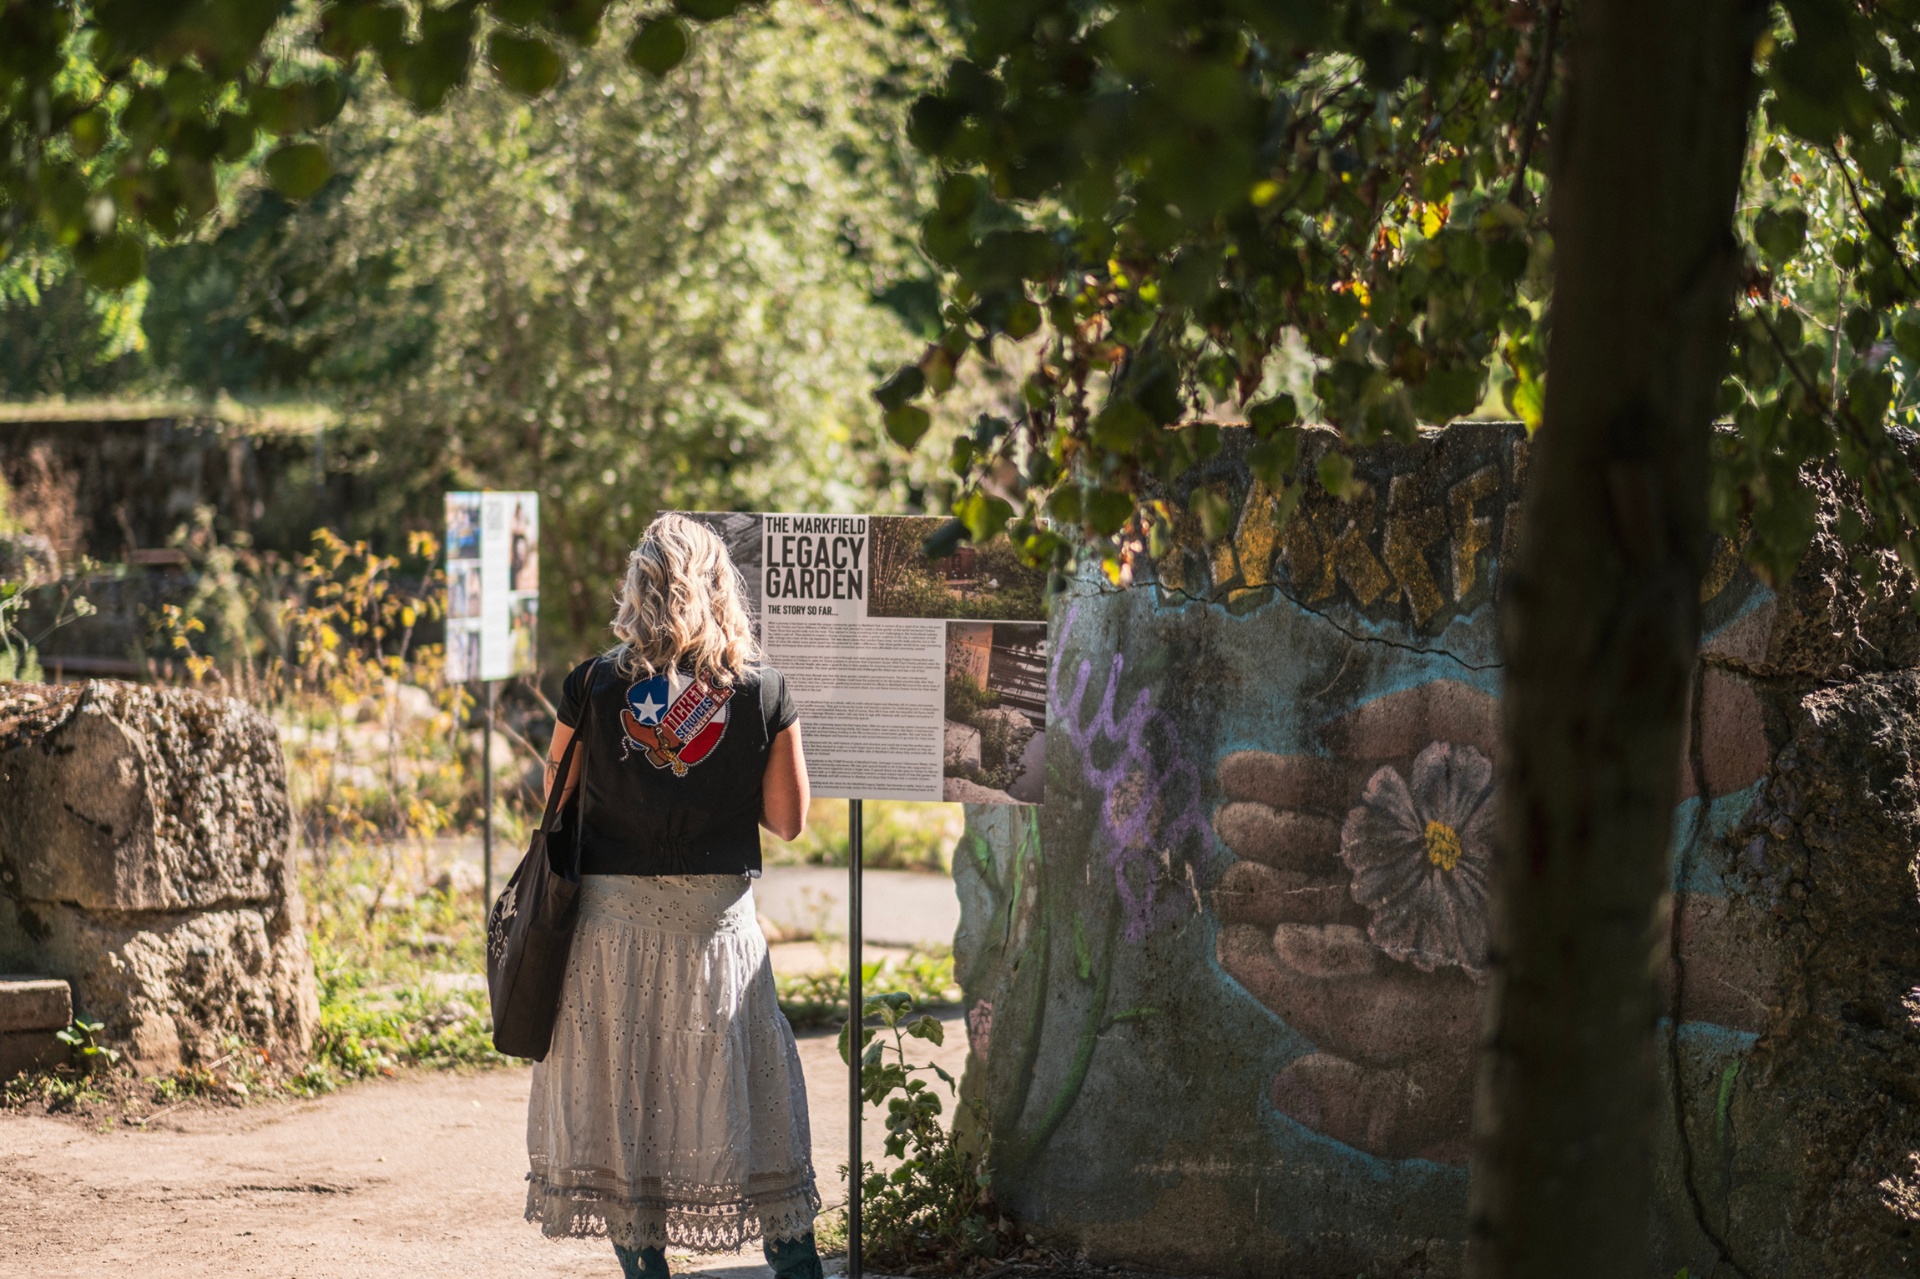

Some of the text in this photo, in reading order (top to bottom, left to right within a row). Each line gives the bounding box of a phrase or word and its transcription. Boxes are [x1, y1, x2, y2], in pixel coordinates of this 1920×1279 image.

[765, 517, 866, 535] THE MARKFIELD
[767, 535, 865, 569] LEGACY
[766, 567, 863, 600] GARDEN
[768, 605, 781, 615] THE
[783, 605, 806, 615] STORY
[807, 606, 817, 616] SO
[661, 684, 704, 731] TICKET
[675, 696, 714, 740] SERVICES
